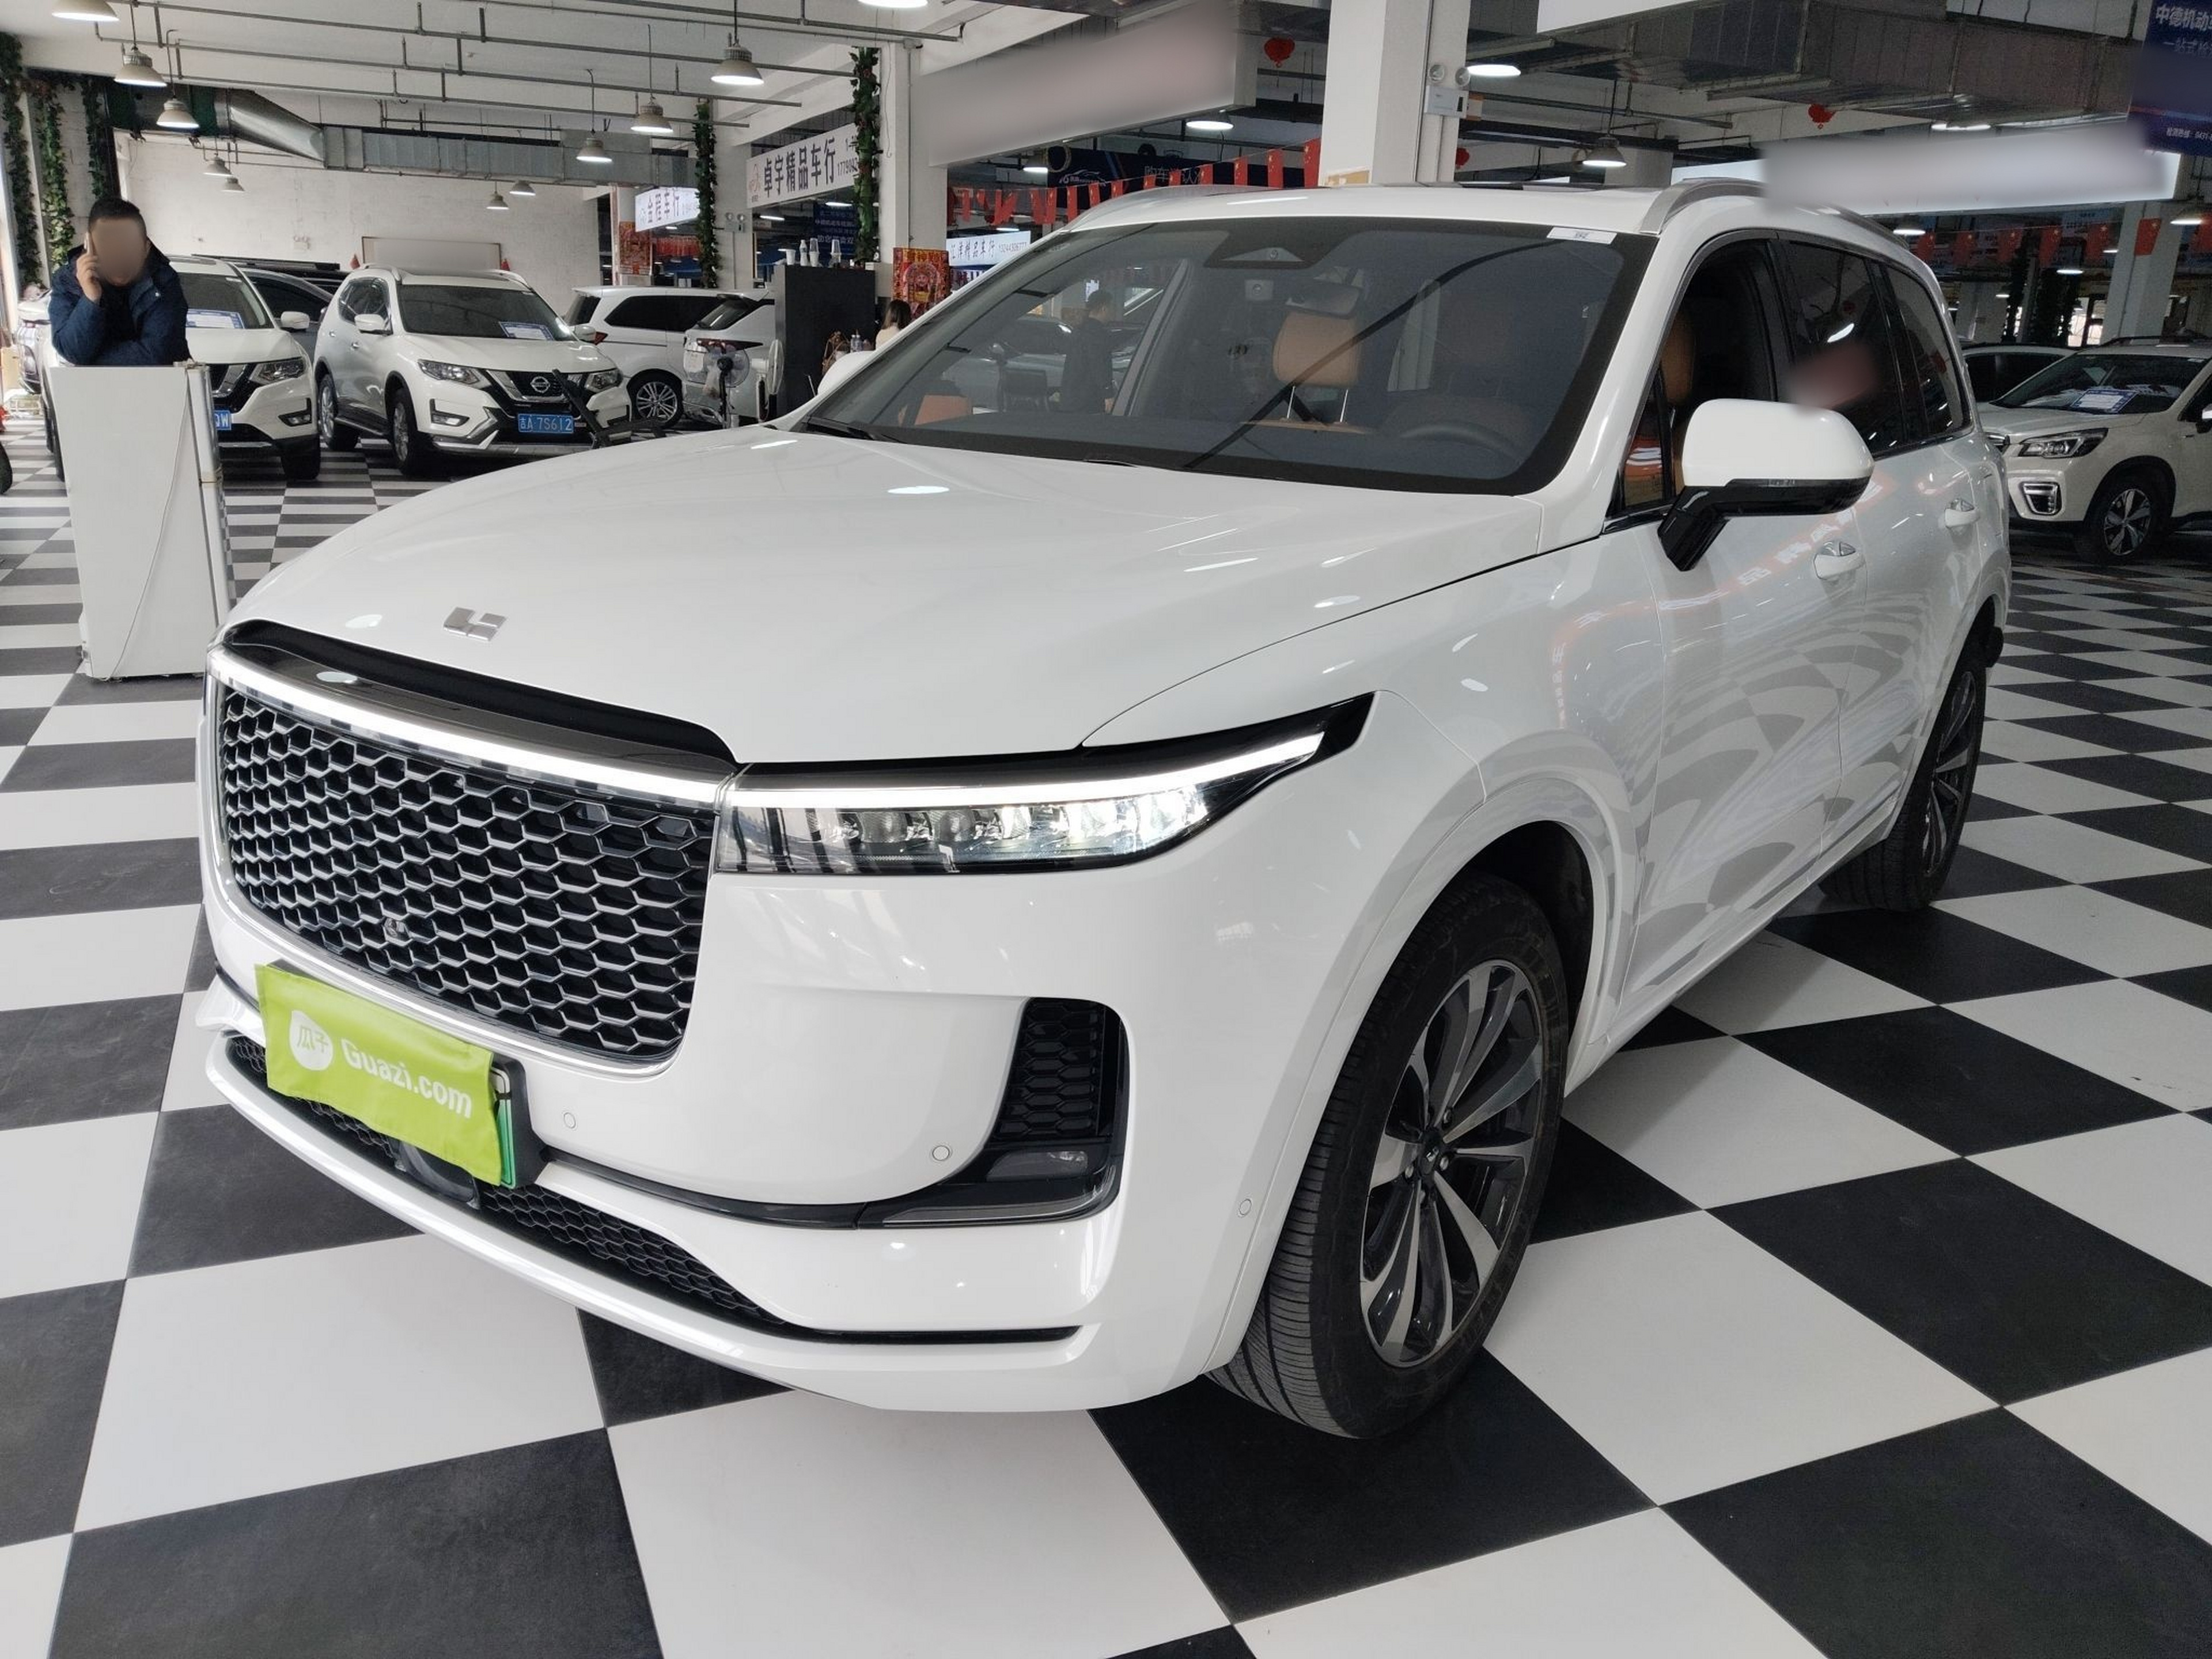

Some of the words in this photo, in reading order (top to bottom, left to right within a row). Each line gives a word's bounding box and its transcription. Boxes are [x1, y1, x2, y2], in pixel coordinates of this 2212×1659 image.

[764, 137, 835, 198] 卓宇精品车行
[297, 1025, 328, 1054] 瓜子
[340, 1039, 472, 1119] Guazi.com
